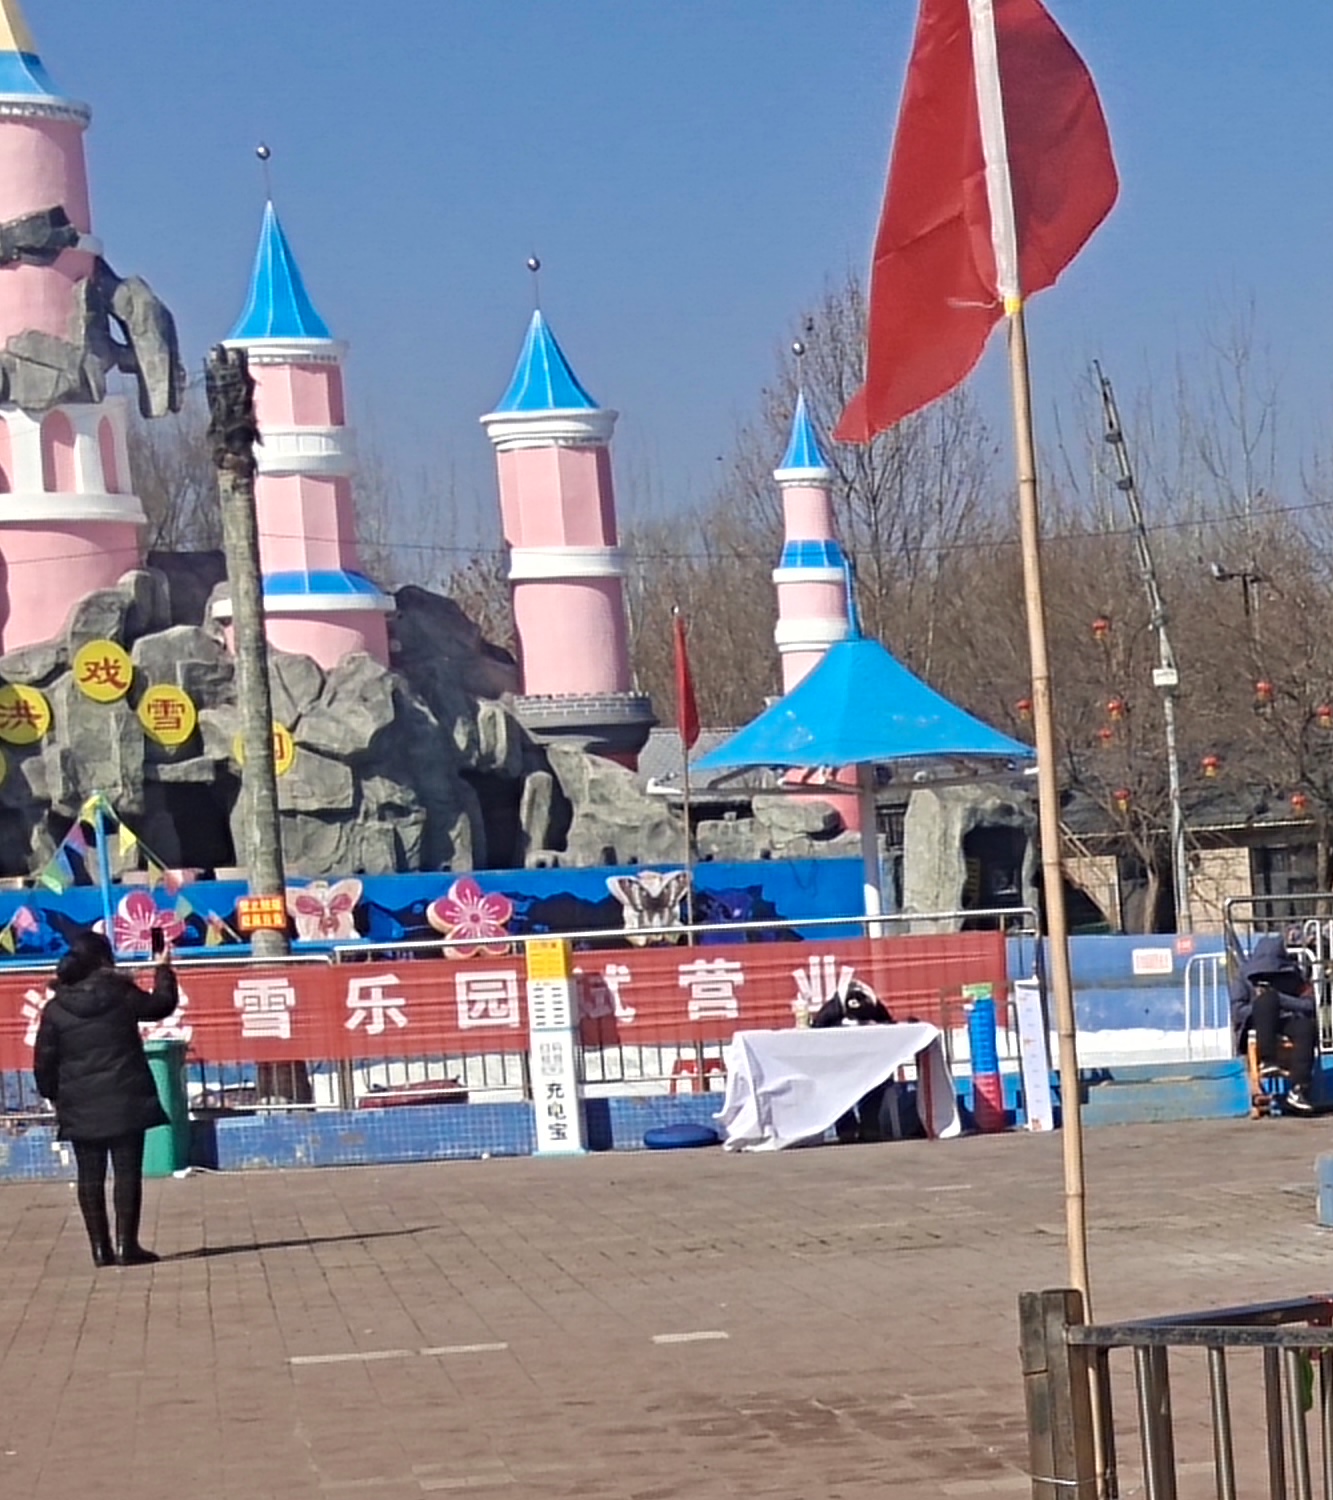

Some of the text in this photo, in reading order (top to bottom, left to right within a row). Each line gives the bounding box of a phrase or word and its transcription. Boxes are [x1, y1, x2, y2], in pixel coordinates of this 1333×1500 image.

[80, 656, 127, 690] 戏
[147, 698, 185, 731] 雪
[20, 954, 854, 1047] 雪乐园试营业
[547, 1082, 567, 1140] 充电宝
